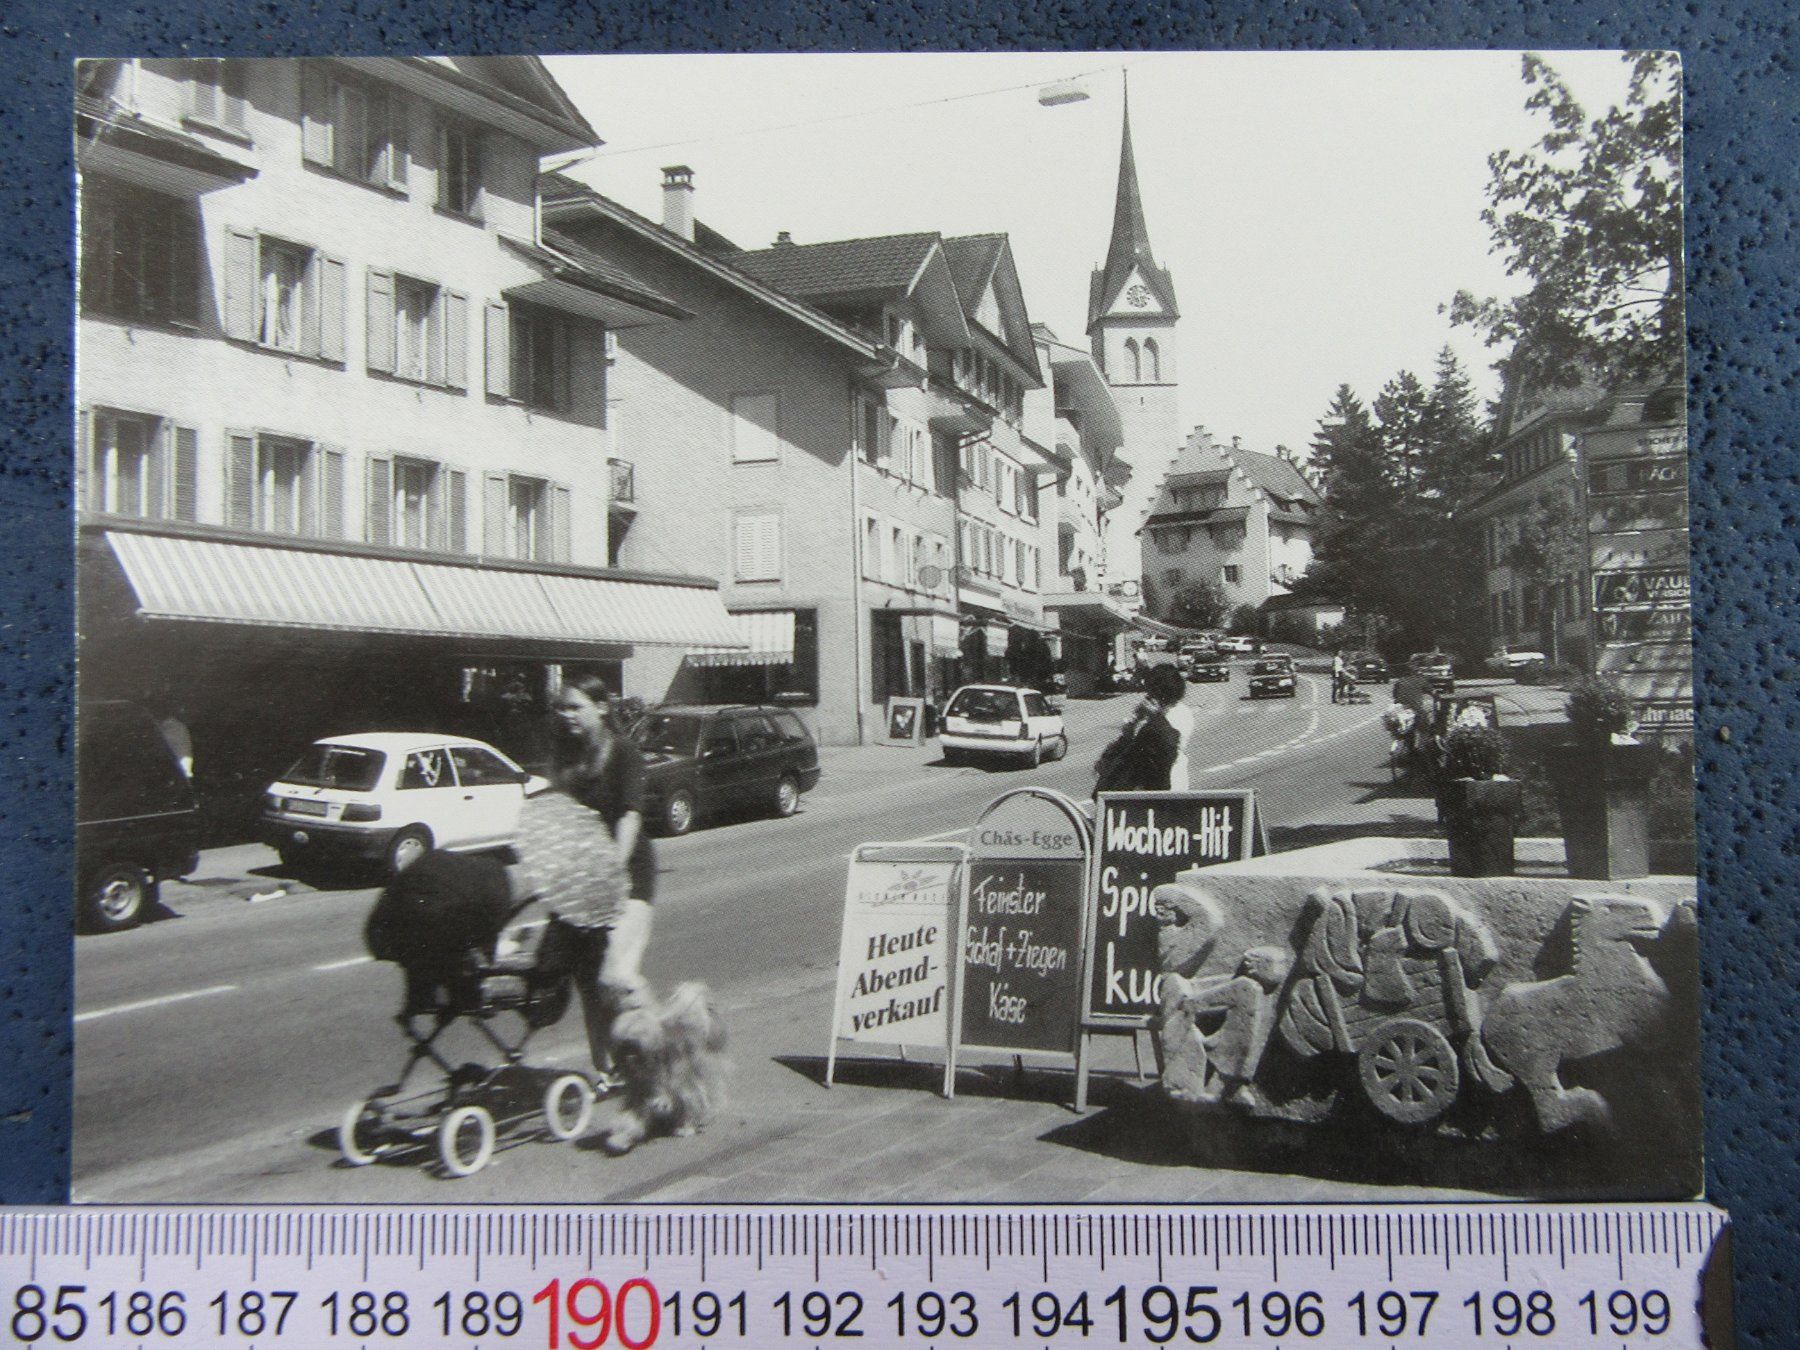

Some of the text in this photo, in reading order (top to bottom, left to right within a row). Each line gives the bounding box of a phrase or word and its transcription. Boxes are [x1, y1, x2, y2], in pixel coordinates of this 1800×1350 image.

[980, 830, 1073, 850] Chäs-Egge
[1107, 805, 1234, 860] Wochen-Hit
[867, 925, 938, 961] Heute
[851, 955, 939, 999] Abend-
[852, 985, 945, 1033] verkauf
[988, 981, 1028, 1024] Käse
[12, 1277, 1671, 1350] 85 186 187 188 189 190 191 192 193 194 195 196 197 198 199
